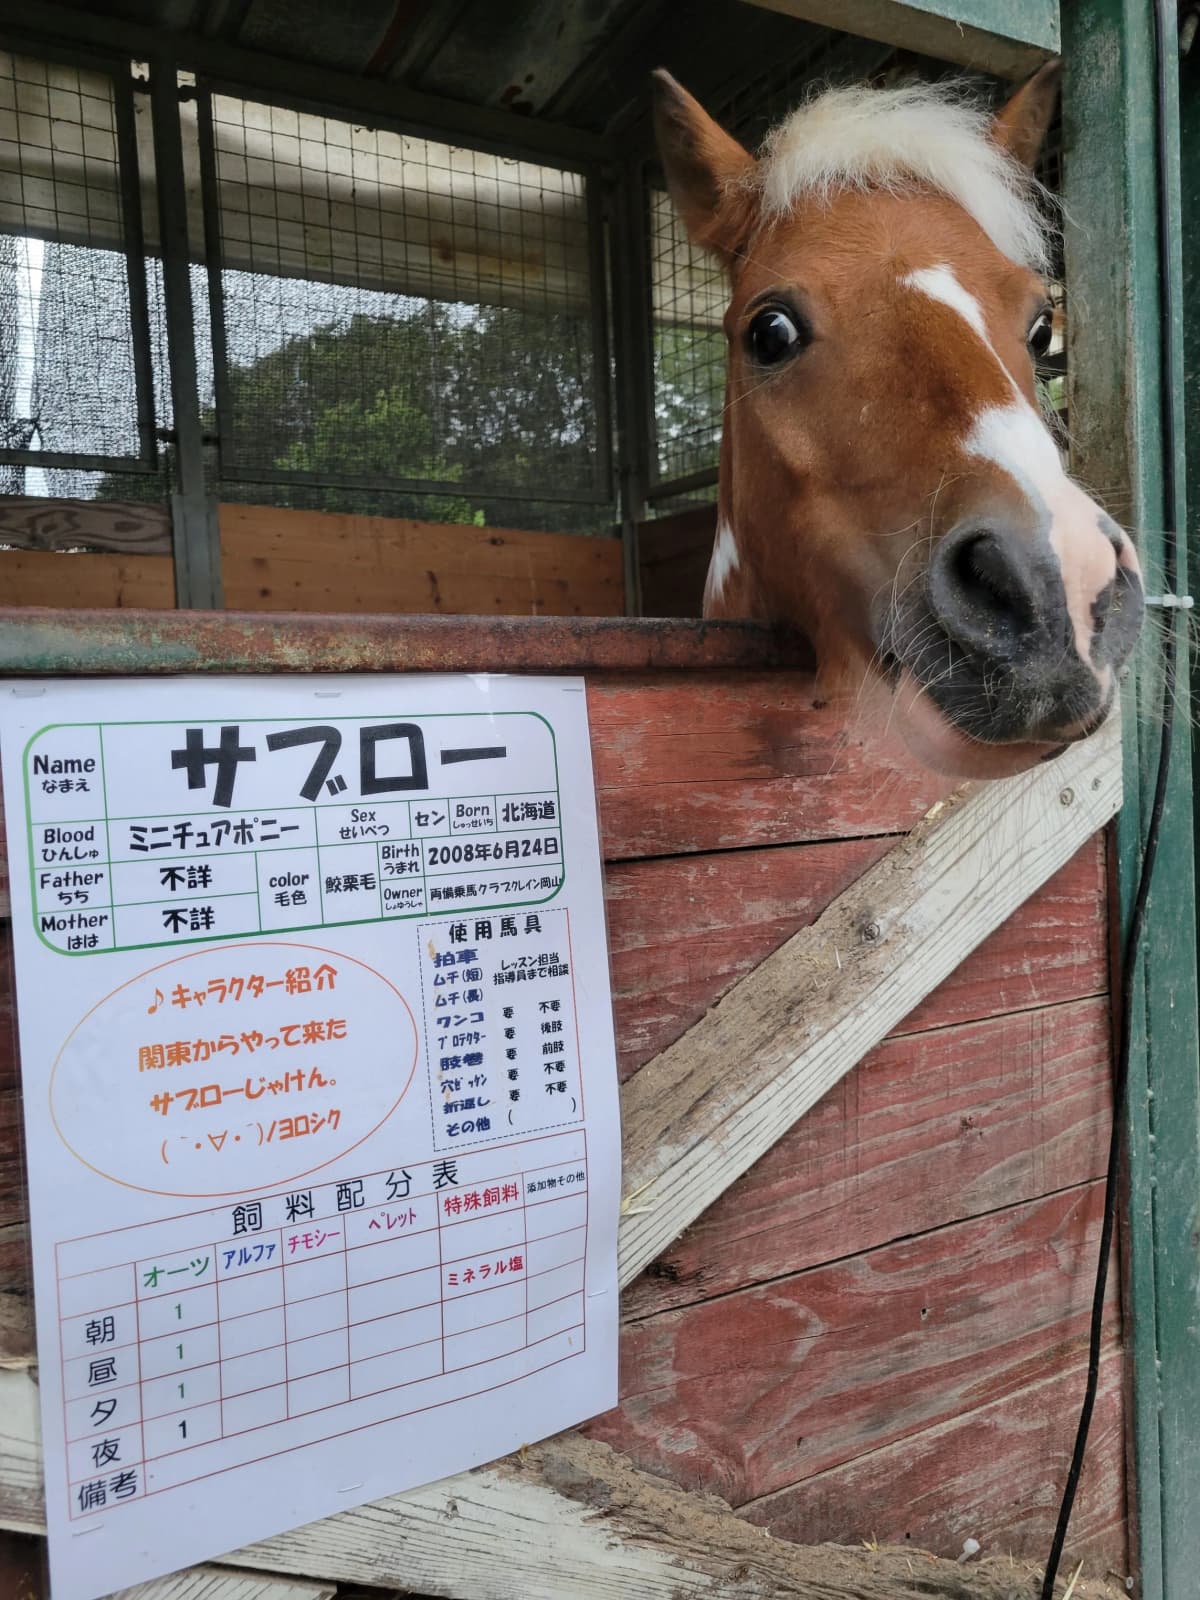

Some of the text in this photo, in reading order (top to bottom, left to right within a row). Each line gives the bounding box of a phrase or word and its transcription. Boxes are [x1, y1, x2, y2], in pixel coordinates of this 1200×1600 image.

[33, 755, 96, 774] Name
[171, 723, 507, 808] サブロー
[42, 779, 90, 793] なまえ
[351, 809, 376, 822] Sex
[414, 812, 445, 827] セン
[456, 804, 489, 818] Born
[502, 801, 555, 822] 北海道
[453, 817, 494, 829] しゅっせいち
[44, 827, 94, 844] Blood
[130, 818, 300, 852] ミニチュアポニー
[339, 825, 390, 840] せいべつ
[42, 846, 99, 862] ひんしゅ
[382, 843, 420, 859] Birth
[428, 837, 559, 865] 2008年6月24日
[383, 860, 420, 874] うまれ
[40, 871, 104, 889] Father
[160, 865, 212, 892] 不詳
[269, 872, 310, 888] color
[58, 891, 89, 905] ちち
[274, 890, 308, 907] 毛色
[383, 887, 423, 900] Owner
[41, 914, 108, 932] Mother
[162, 906, 215, 933] 不詳
[449, 915, 542, 943] 使用馬具
[68, 934, 99, 950] はは
[434, 949, 479, 968] 拍車
[501, 952, 559, 970] レッスン担当
[493, 965, 570, 985] 指導員まで相談
[503, 1007, 514, 1019] 要
[539, 1000, 561, 1013] 不要
[437, 1012, 484, 1028] ワンコ
[504, 1028, 516, 1039] 要
[138, 1018, 348, 1072] 関東からやって来た
[506, 1048, 517, 1060] 要
[542, 1041, 565, 1055] 前肢
[508, 1068, 519, 1080] 要
[544, 1060, 565, 1074] 不要
[509, 1089, 521, 1101] 要
[546, 1081, 567, 1095] 不要
[446, 1117, 491, 1137] その他
[527, 1170, 585, 1194] 添加物その他
[233, 1160, 459, 1235] 飼料配分表
[444, 1182, 520, 1217] 特殊飼料
[369, 1207, 417, 1231] ペレット
[288, 1229, 341, 1254] チモシー
[223, 1243, 276, 1270] アルファ
[143, 1256, 211, 1288] オーツ
[448, 1256, 524, 1287] ミネラル塩
[175, 1303, 183, 1320] 1
[85, 1315, 115, 1346] 朝
[176, 1343, 184, 1360] 1
[88, 1356, 118, 1388] 昼
[177, 1382, 186, 1399] 1
[90, 1397, 117, 1427] 夕
[178, 1420, 188, 1439] 1
[91, 1439, 121, 1469] 夜
[77, 1470, 138, 1512] 備考
